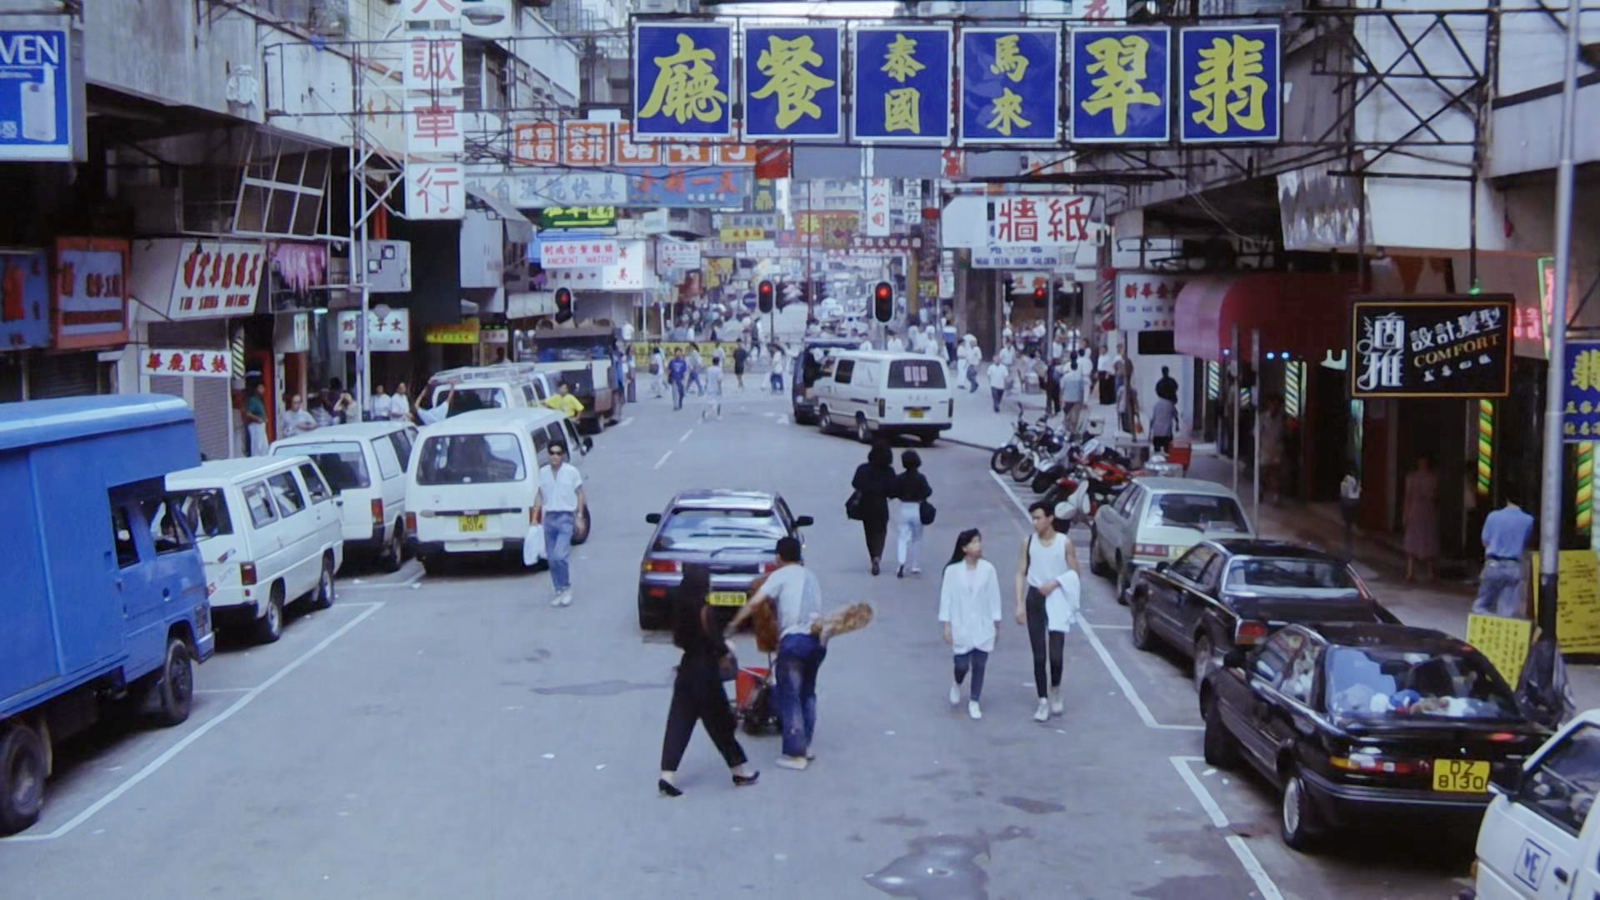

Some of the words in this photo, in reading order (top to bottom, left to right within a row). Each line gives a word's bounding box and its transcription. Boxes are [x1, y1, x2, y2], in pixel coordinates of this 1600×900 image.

[547, 256, 578, 265] ANCIENT
[586, 256, 613, 264] WATCH
[1413, 333, 1500, 367] COMFORT
[1438, 774, 1484, 790] 8130
